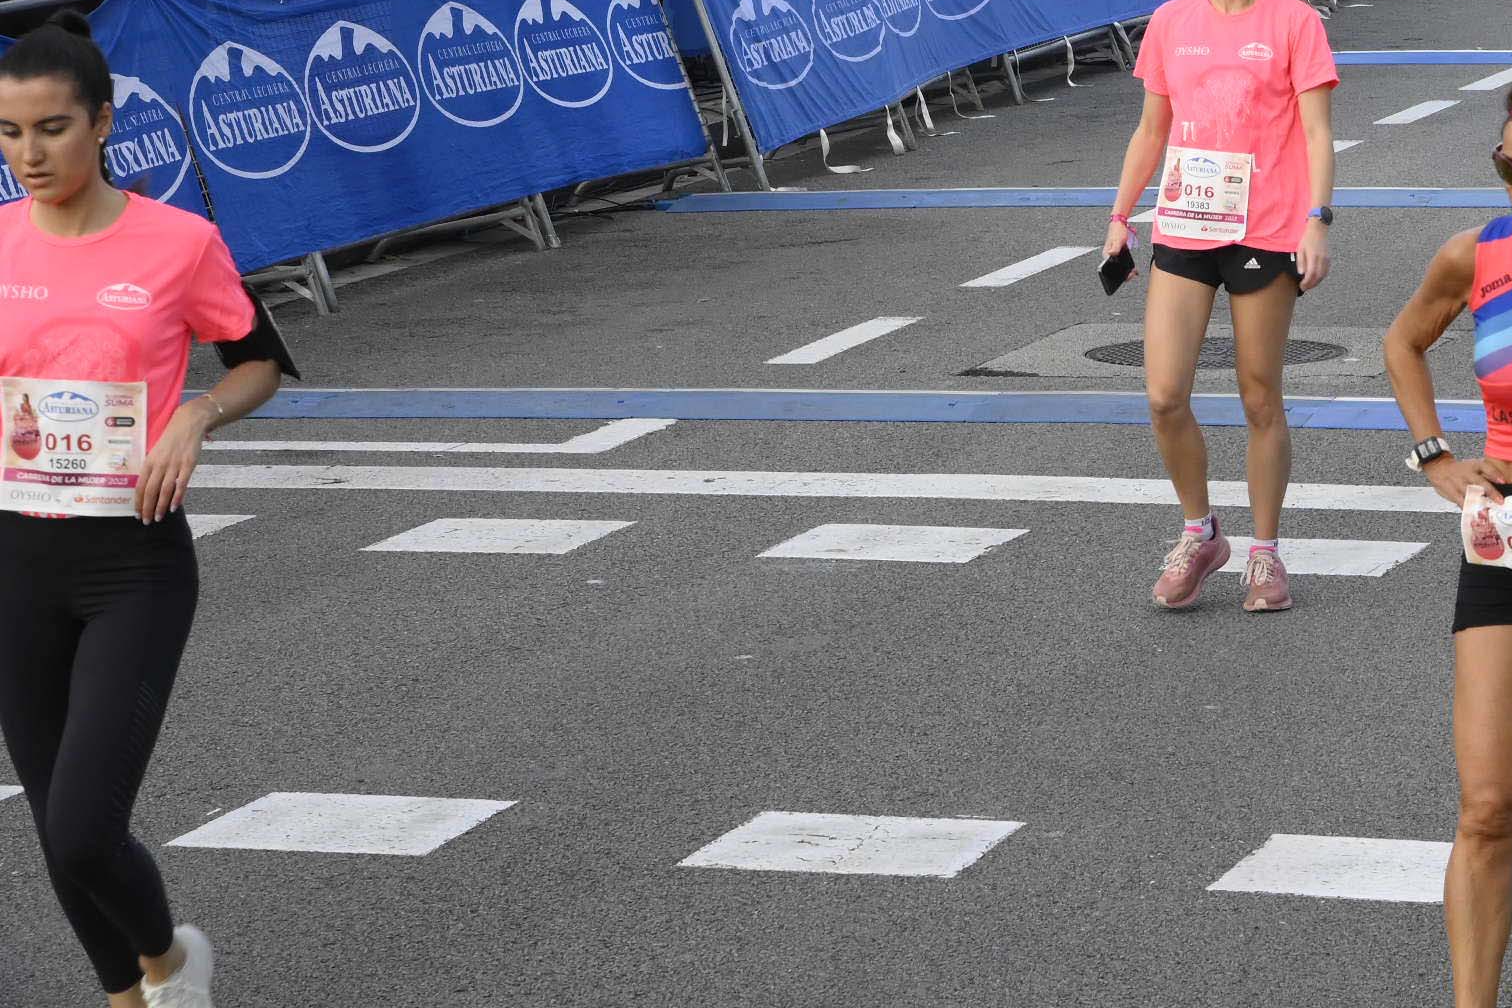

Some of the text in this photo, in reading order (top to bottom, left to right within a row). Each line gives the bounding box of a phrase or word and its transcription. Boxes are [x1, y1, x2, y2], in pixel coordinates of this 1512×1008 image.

[437, 39, 504, 61] CENTRAL LECHERA
[1175, 45, 1211, 56] OYSHO
[523, 35, 608, 82] ASTURIANA
[325, 58, 400, 84] CENTRAL LECHERA
[427, 52, 519, 102] ASTURIANA
[212, 86, 251, 106] CENTRAL
[315, 76, 416, 127] ASTURIANA
[201, 98, 305, 151] ASTURIANA
[1184, 183, 1215, 199] 016
[1186, 200, 1210, 210] 19383
[1187, 211, 1194, 219] DE
[1194, 212, 1203, 220] LA
[101, 292, 147, 305] ASTURIANA
[44, 399, 94, 417] ASTURIANA
[104, 399, 134, 408] SUMA
[45, 433, 93, 452] 016
[49, 458, 87, 470] 15260
[52, 474, 63, 484] DE
[65, 475, 77, 485] LA
[10, 491, 53, 503] OYSHO
[84, 495, 132, 505] Santander
